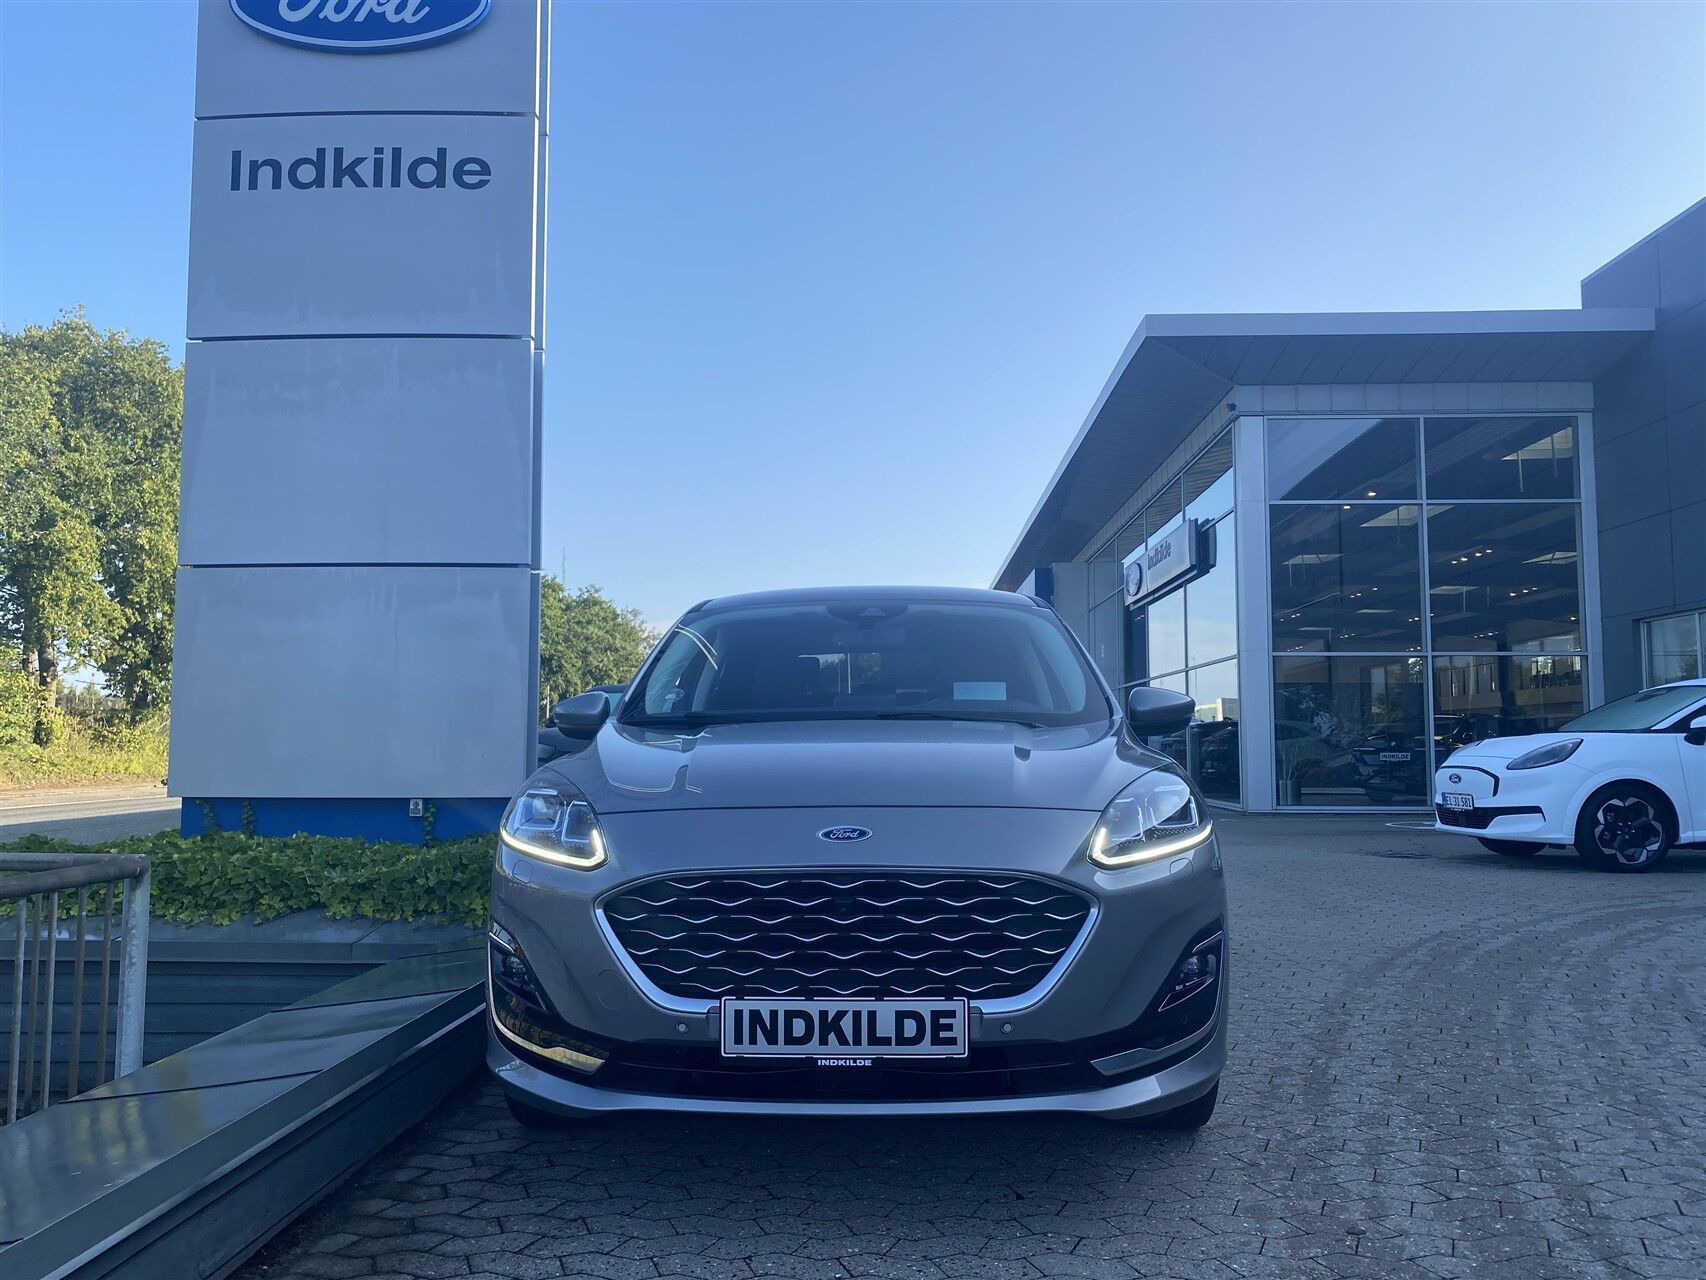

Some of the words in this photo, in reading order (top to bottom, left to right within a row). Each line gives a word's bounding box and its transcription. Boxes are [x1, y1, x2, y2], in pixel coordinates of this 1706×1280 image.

[230, 147, 492, 191] Indkilde
[830, 828, 860, 839] Ford
[733, 1009, 958, 1047] INDKILDE
